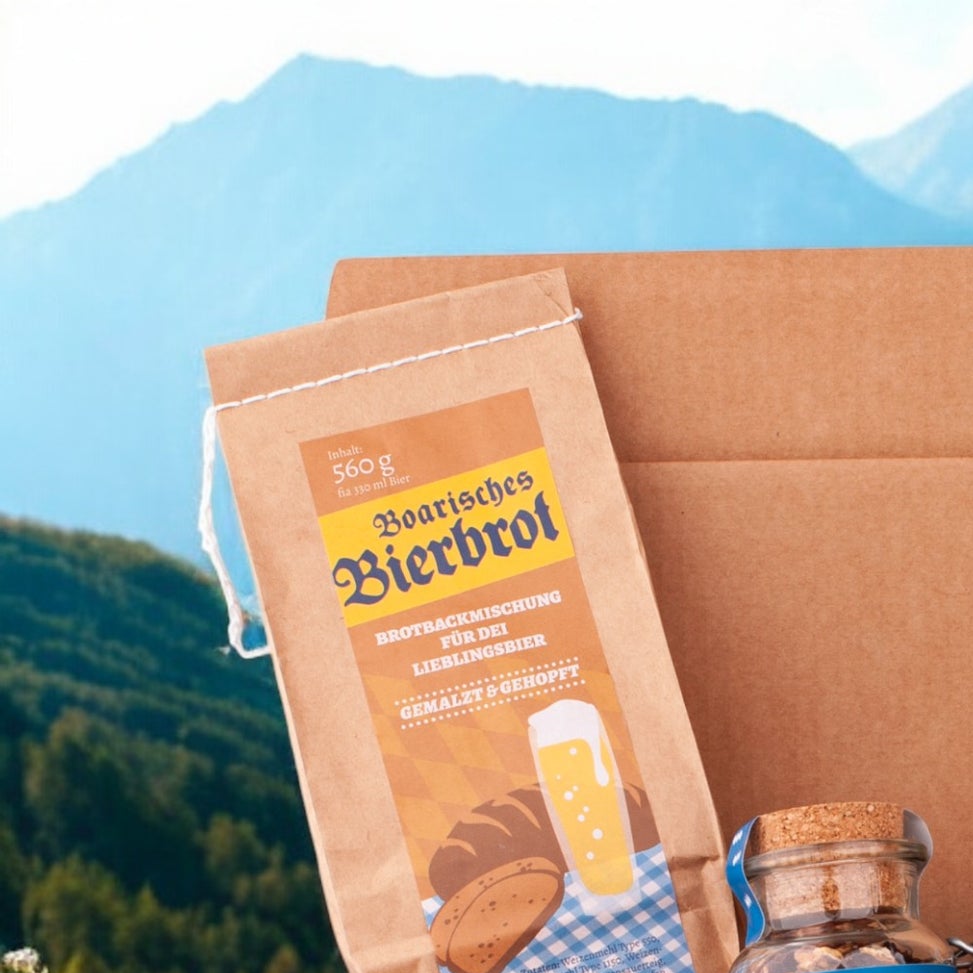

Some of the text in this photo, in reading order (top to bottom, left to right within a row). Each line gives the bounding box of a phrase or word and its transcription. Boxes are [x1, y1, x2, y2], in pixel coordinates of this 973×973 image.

[328, 445, 363, 460] Inhalt:
[333, 454, 395, 485] 560 g
[354, 483, 371, 496] 330
[373, 477, 387, 490] ml
[389, 474, 412, 486] Bier
[373, 470, 534, 538] Boarisches
[332, 491, 559, 607] Bierbrot
[375, 590, 562, 646] BROTBACKMISCHUNG
[440, 622, 509, 649] FÜR DEI
[412, 634, 547, 677] LIEBLINGSBIER
[400, 664, 580, 720] GEMALZT & GEHOPFT
